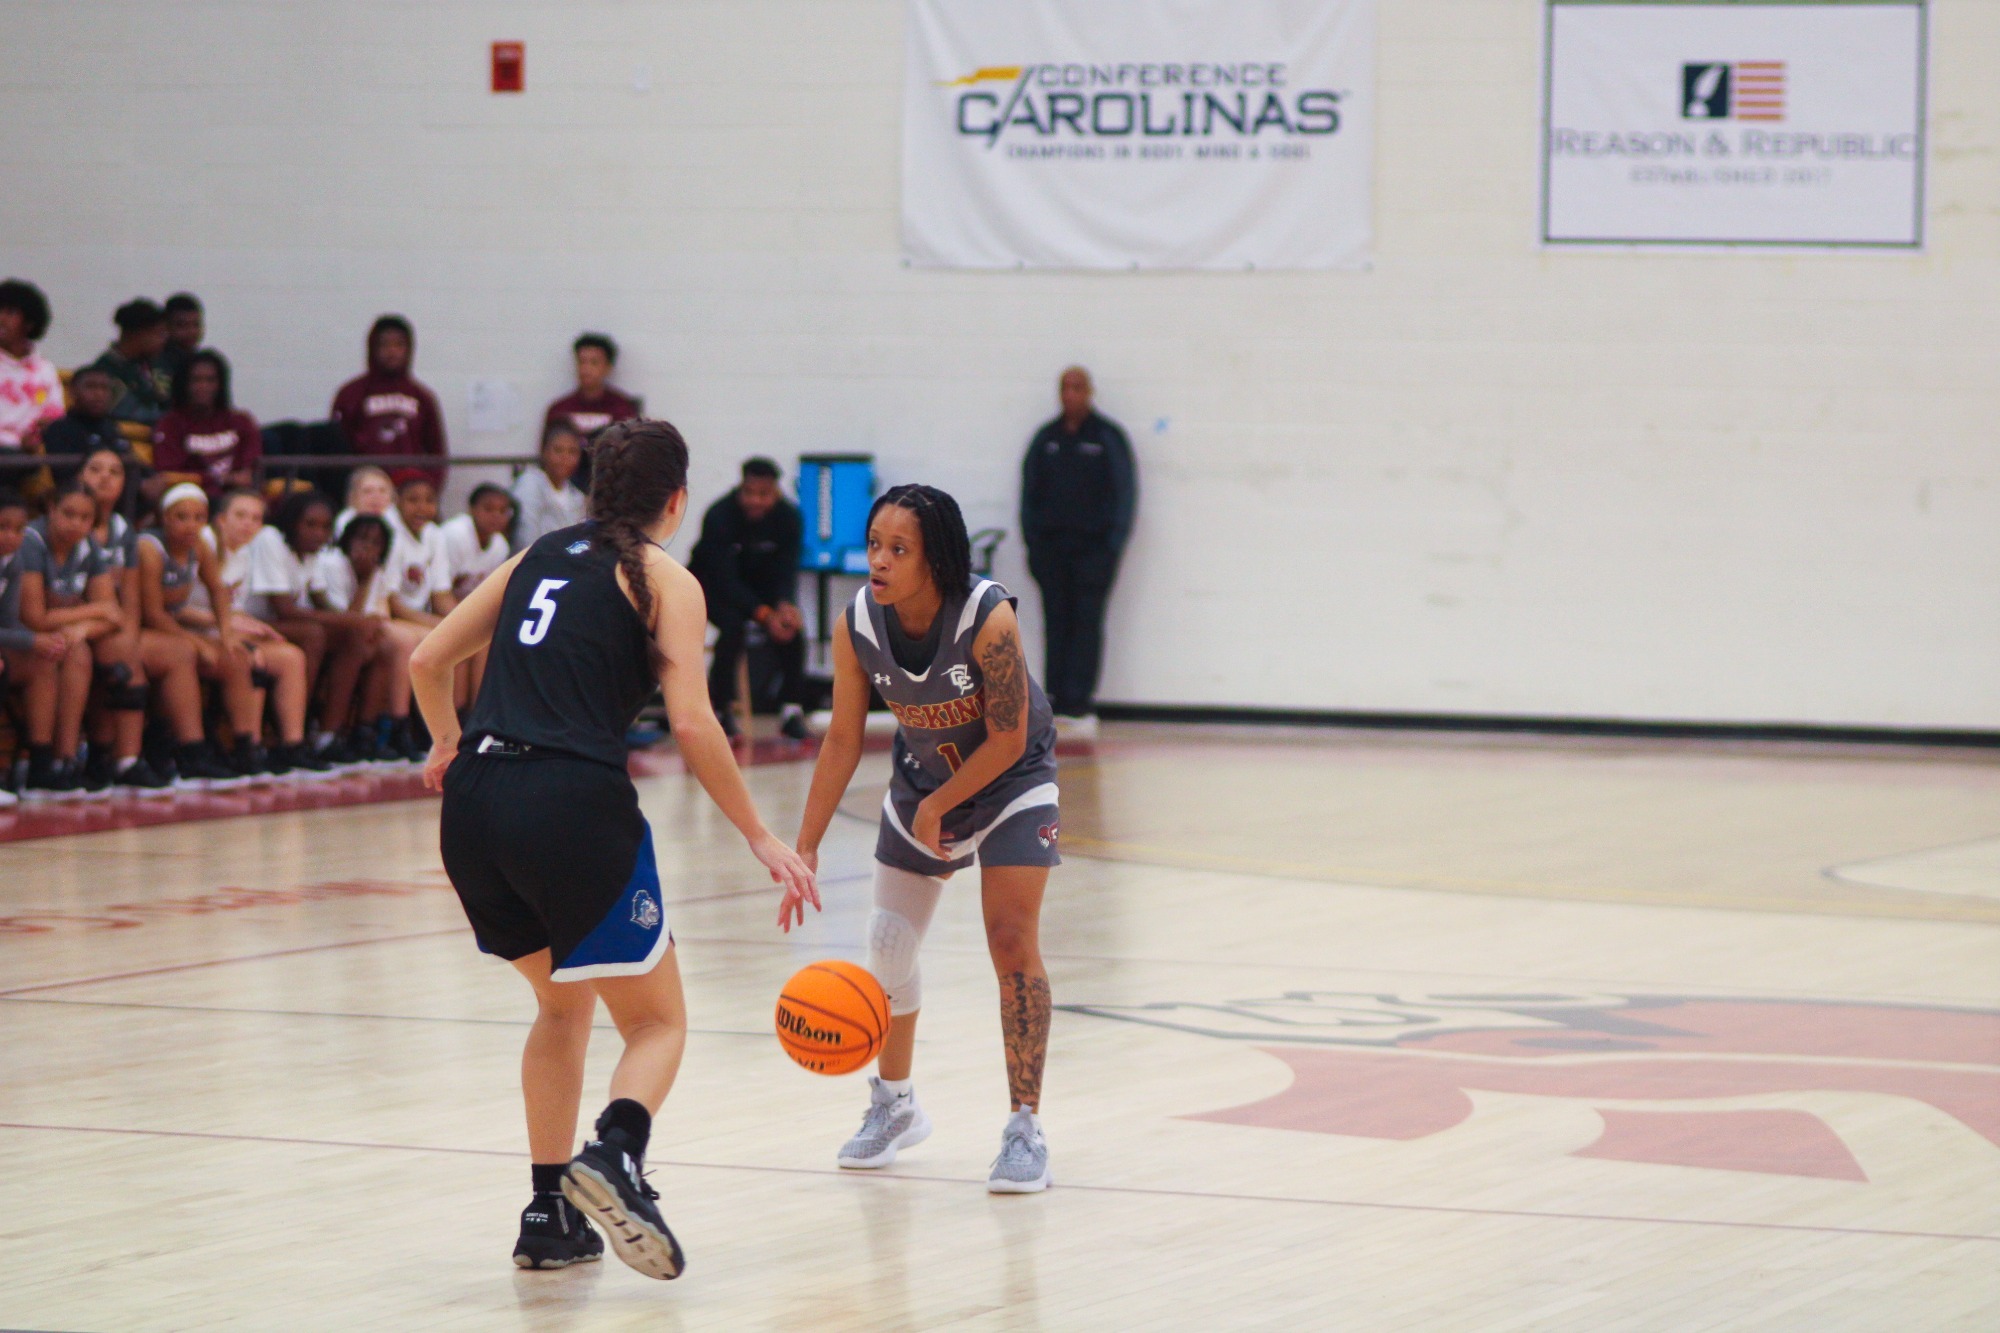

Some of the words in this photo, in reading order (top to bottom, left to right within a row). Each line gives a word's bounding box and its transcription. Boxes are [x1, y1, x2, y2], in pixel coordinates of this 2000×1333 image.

[1038, 65, 1287, 88] CONFERENCE
[957, 86, 1340, 148] CAROLINAS
[1552, 128, 1696, 157] REASON
[1703, 128, 1730, 157] &
[1741, 128, 1916, 160] REPUBLIC
[518, 577, 570, 646] 5
[886, 692, 985, 730] RSKIN
[937, 742, 964, 774] 1
[777, 1004, 842, 1045] Wilson
